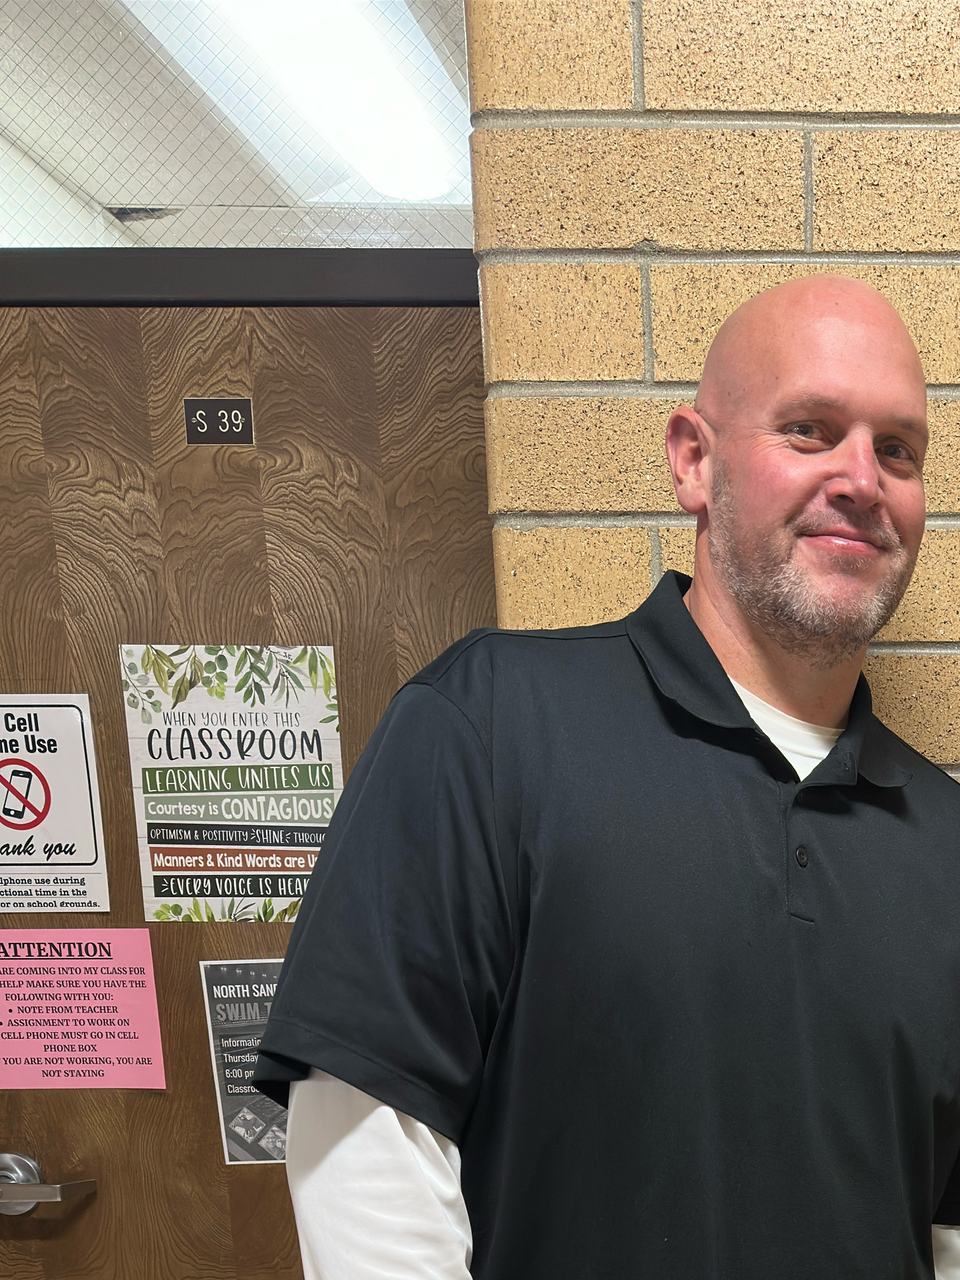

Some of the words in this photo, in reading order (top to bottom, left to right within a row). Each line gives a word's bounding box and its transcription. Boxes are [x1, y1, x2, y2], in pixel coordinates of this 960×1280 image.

[196, 410, 208, 433] S
[218, 410, 243, 433] 39
[4, 712, 40, 733] Cell
[163, 712, 196, 727] WHEN
[201, 712, 227, 727] YOU
[232, 712, 269, 727] ENTER
[273, 712, 301, 727] THIS
[24, 735, 58, 753] Use
[147, 728, 323, 761] CLASSROOM
[145, 768, 232, 792] LEARNING
[237, 766, 300, 790] UNITES
[308, 765, 331, 787] US
[147, 802, 205, 818] Courtesy
[209, 802, 219, 815] is
[221, 796, 333, 821] CONTAGIOUS
[150, 828, 191, 841] OPTIMISM
[193, 830, 200, 840] &
[202, 830, 248, 842] POSITIVITY
[256, 829, 284, 844] SHINE
[43, 842, 77, 861] you
[154, 853, 204, 868] Manners
[206, 853, 214, 868] &
[216, 853, 243, 868] Kind
[244, 854, 282, 868] Words
[284, 856, 305, 868] are
[34, 878, 51, 886] use
[52, 877, 86, 887] during
[169, 877, 212, 895] EVERY
[215, 878, 254, 895] VOICE
[258, 878, 272, 895] IS
[34, 888, 58, 897] time
[59, 888, 69, 897] in
[70, 888, 87, 897] the
[27, 899, 57, 908] school
[59, 900, 101, 910] grounds.
[0, 942, 112, 958] ATTENTION
[16, 967, 56, 975] COMING
[58, 967, 82, 975] INTO
[83, 967, 98, 975] MY
[100, 967, 127, 975] CLASS
[129, 967, 146, 975] FOR
[0, 980, 24, 988] HELP
[26, 980, 54, 988] MAKE
[56, 980, 80, 988] SURE
[82, 980, 101, 988] YOU
[103, 980, 127, 988] HAVE
[128, 980, 147, 988] THE
[5, 993, 62, 1001] FOLLOWING
[63, 993, 90, 1001] WITH
[92, 993, 114, 1001] YOU:
[213, 985, 249, 998] NORTH
[17, 1006, 44, 1014] NOTE
[46, 1006, 73, 1014] FROM
[75, 1006, 118, 1014] TEACHER
[215, 1002, 260, 1021] SWIM
[7, 1019, 70, 1027] ASSIGNMENT
[72, 1019, 86, 1027] TO
[87, 1019, 115, 1027] WORK
[117, 1019, 130, 1027] ON
[1, 1032, 24, 1040] CELL
[26, 1032, 59, 1040] PHONE
[61, 1032, 88, 1040] MUST
[90, 1032, 103, 1040] GO
[105, 1032, 115, 1040] IN
[117, 1032, 139, 1040] CELL
[43, 1044, 76, 1052] PHONE
[78, 1044, 97, 1052] BOX
[4, 1057, 21, 1065] YOU
[23, 1057, 42, 1065] ARE
[44, 1057, 64, 1065] NOT
[66, 1057, 115, 1065] WORKING,
[116, 1057, 134, 1065] YOU
[135, 1057, 153, 1065] ARE
[223, 1053, 259, 1064] Thursday
[41, 1069, 62, 1077] NOT
[64, 1069, 105, 1077] STAYING
[225, 1069, 242, 1079] 6:00
